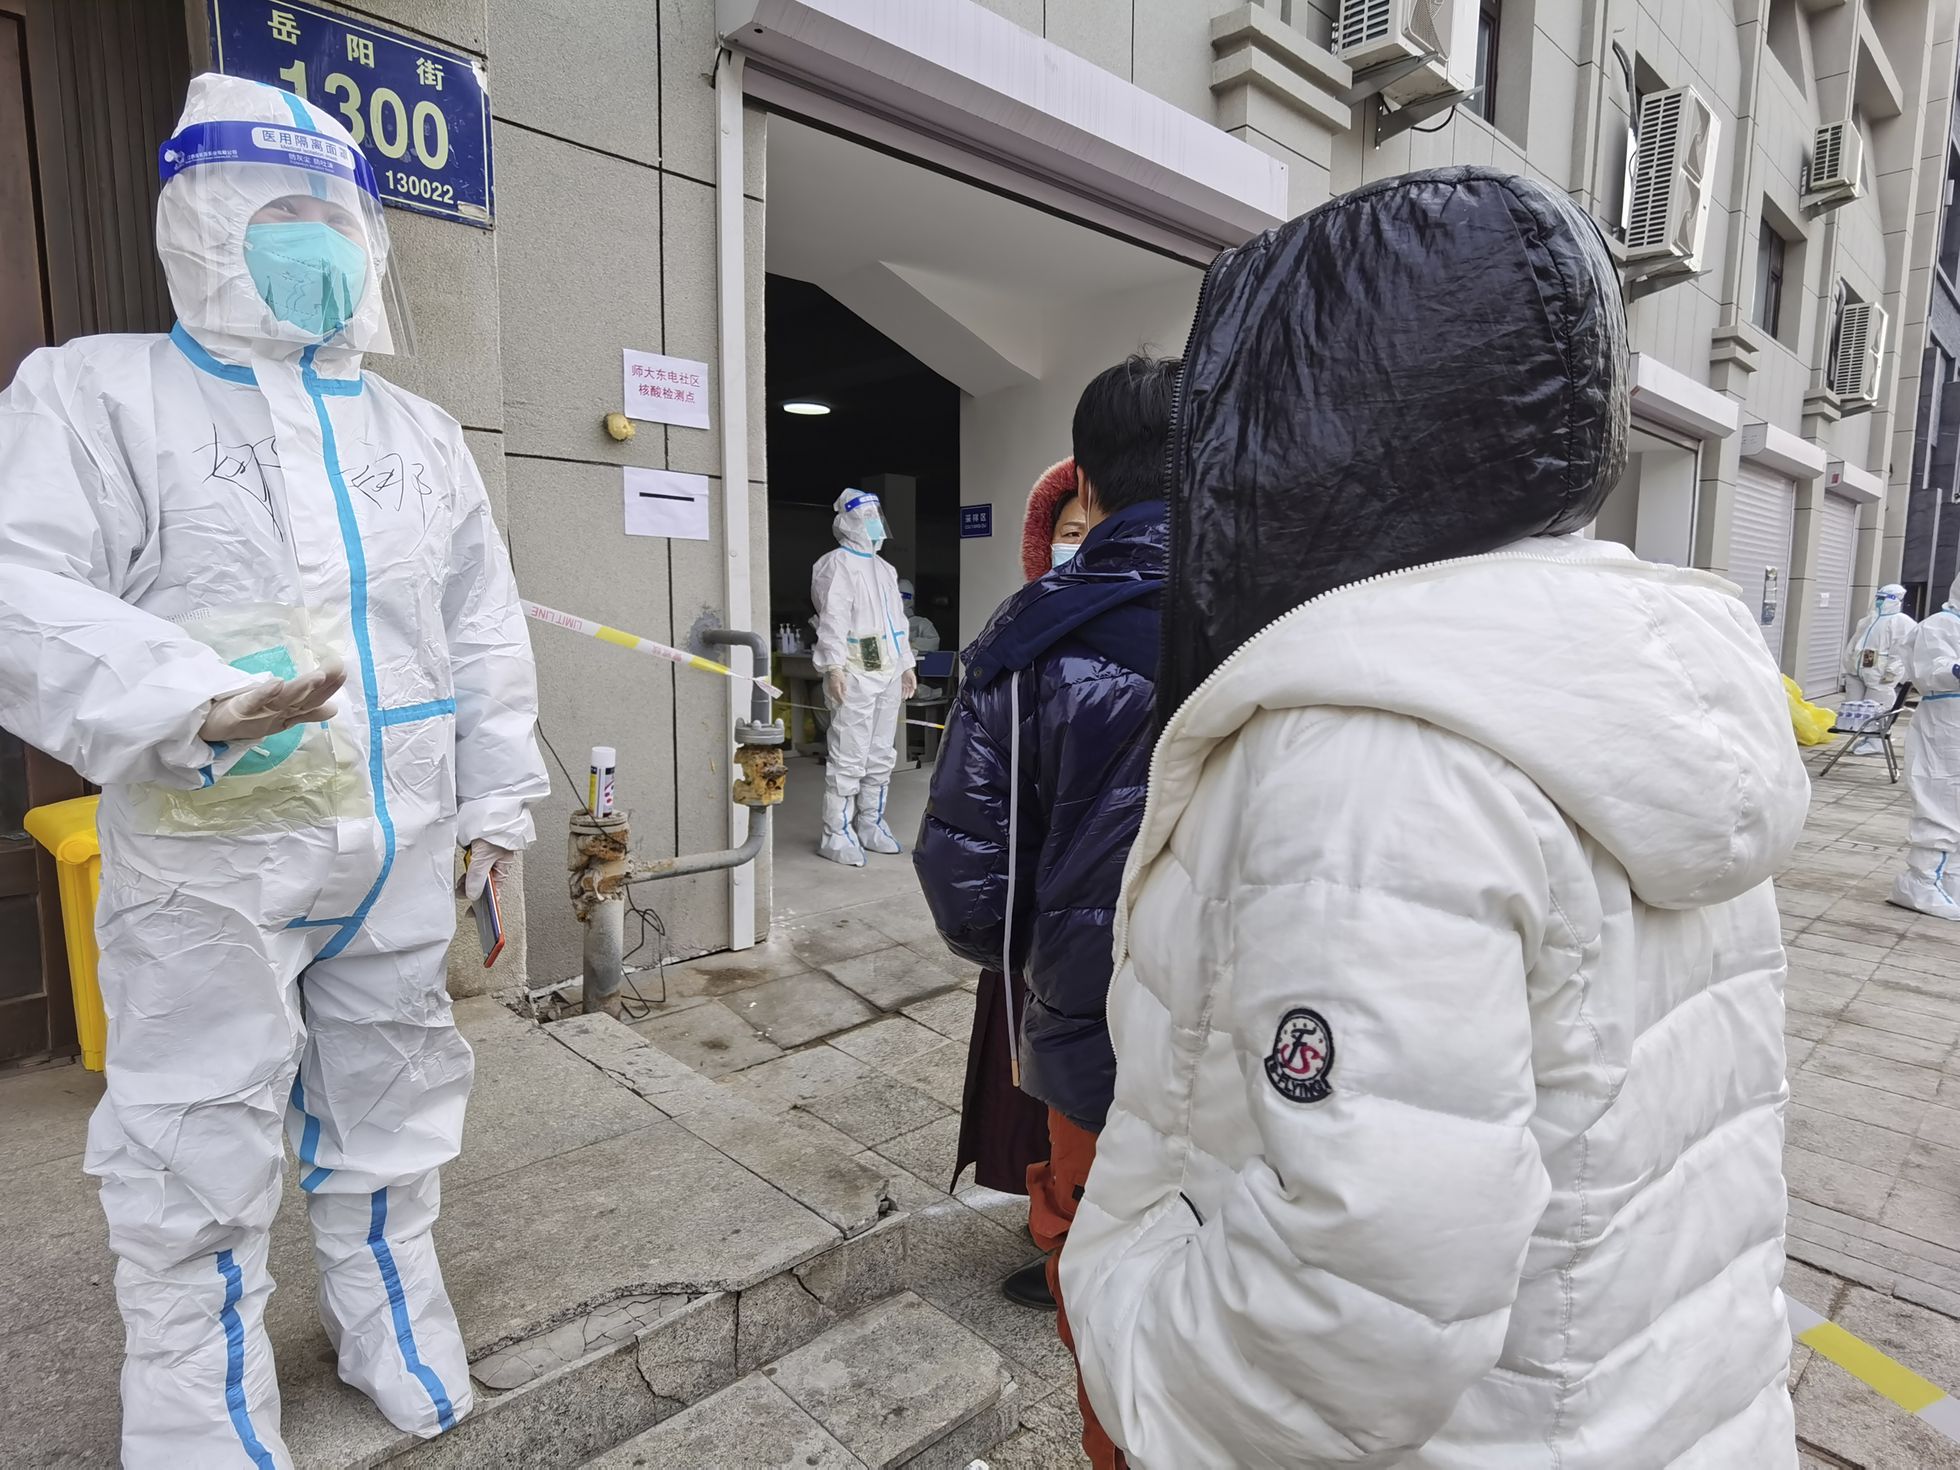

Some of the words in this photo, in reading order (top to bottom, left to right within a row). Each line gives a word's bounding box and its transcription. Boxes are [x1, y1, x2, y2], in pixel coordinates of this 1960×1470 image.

[267, 9, 444, 91] 岳阳街
[385, 170, 454, 204] 130022
[631, 364, 700, 387] 师大东电社区
[638, 383, 695, 403] 核酸检测点
[531, 606, 555, 622] LINE
[555, 615, 583, 631] LIMIT
